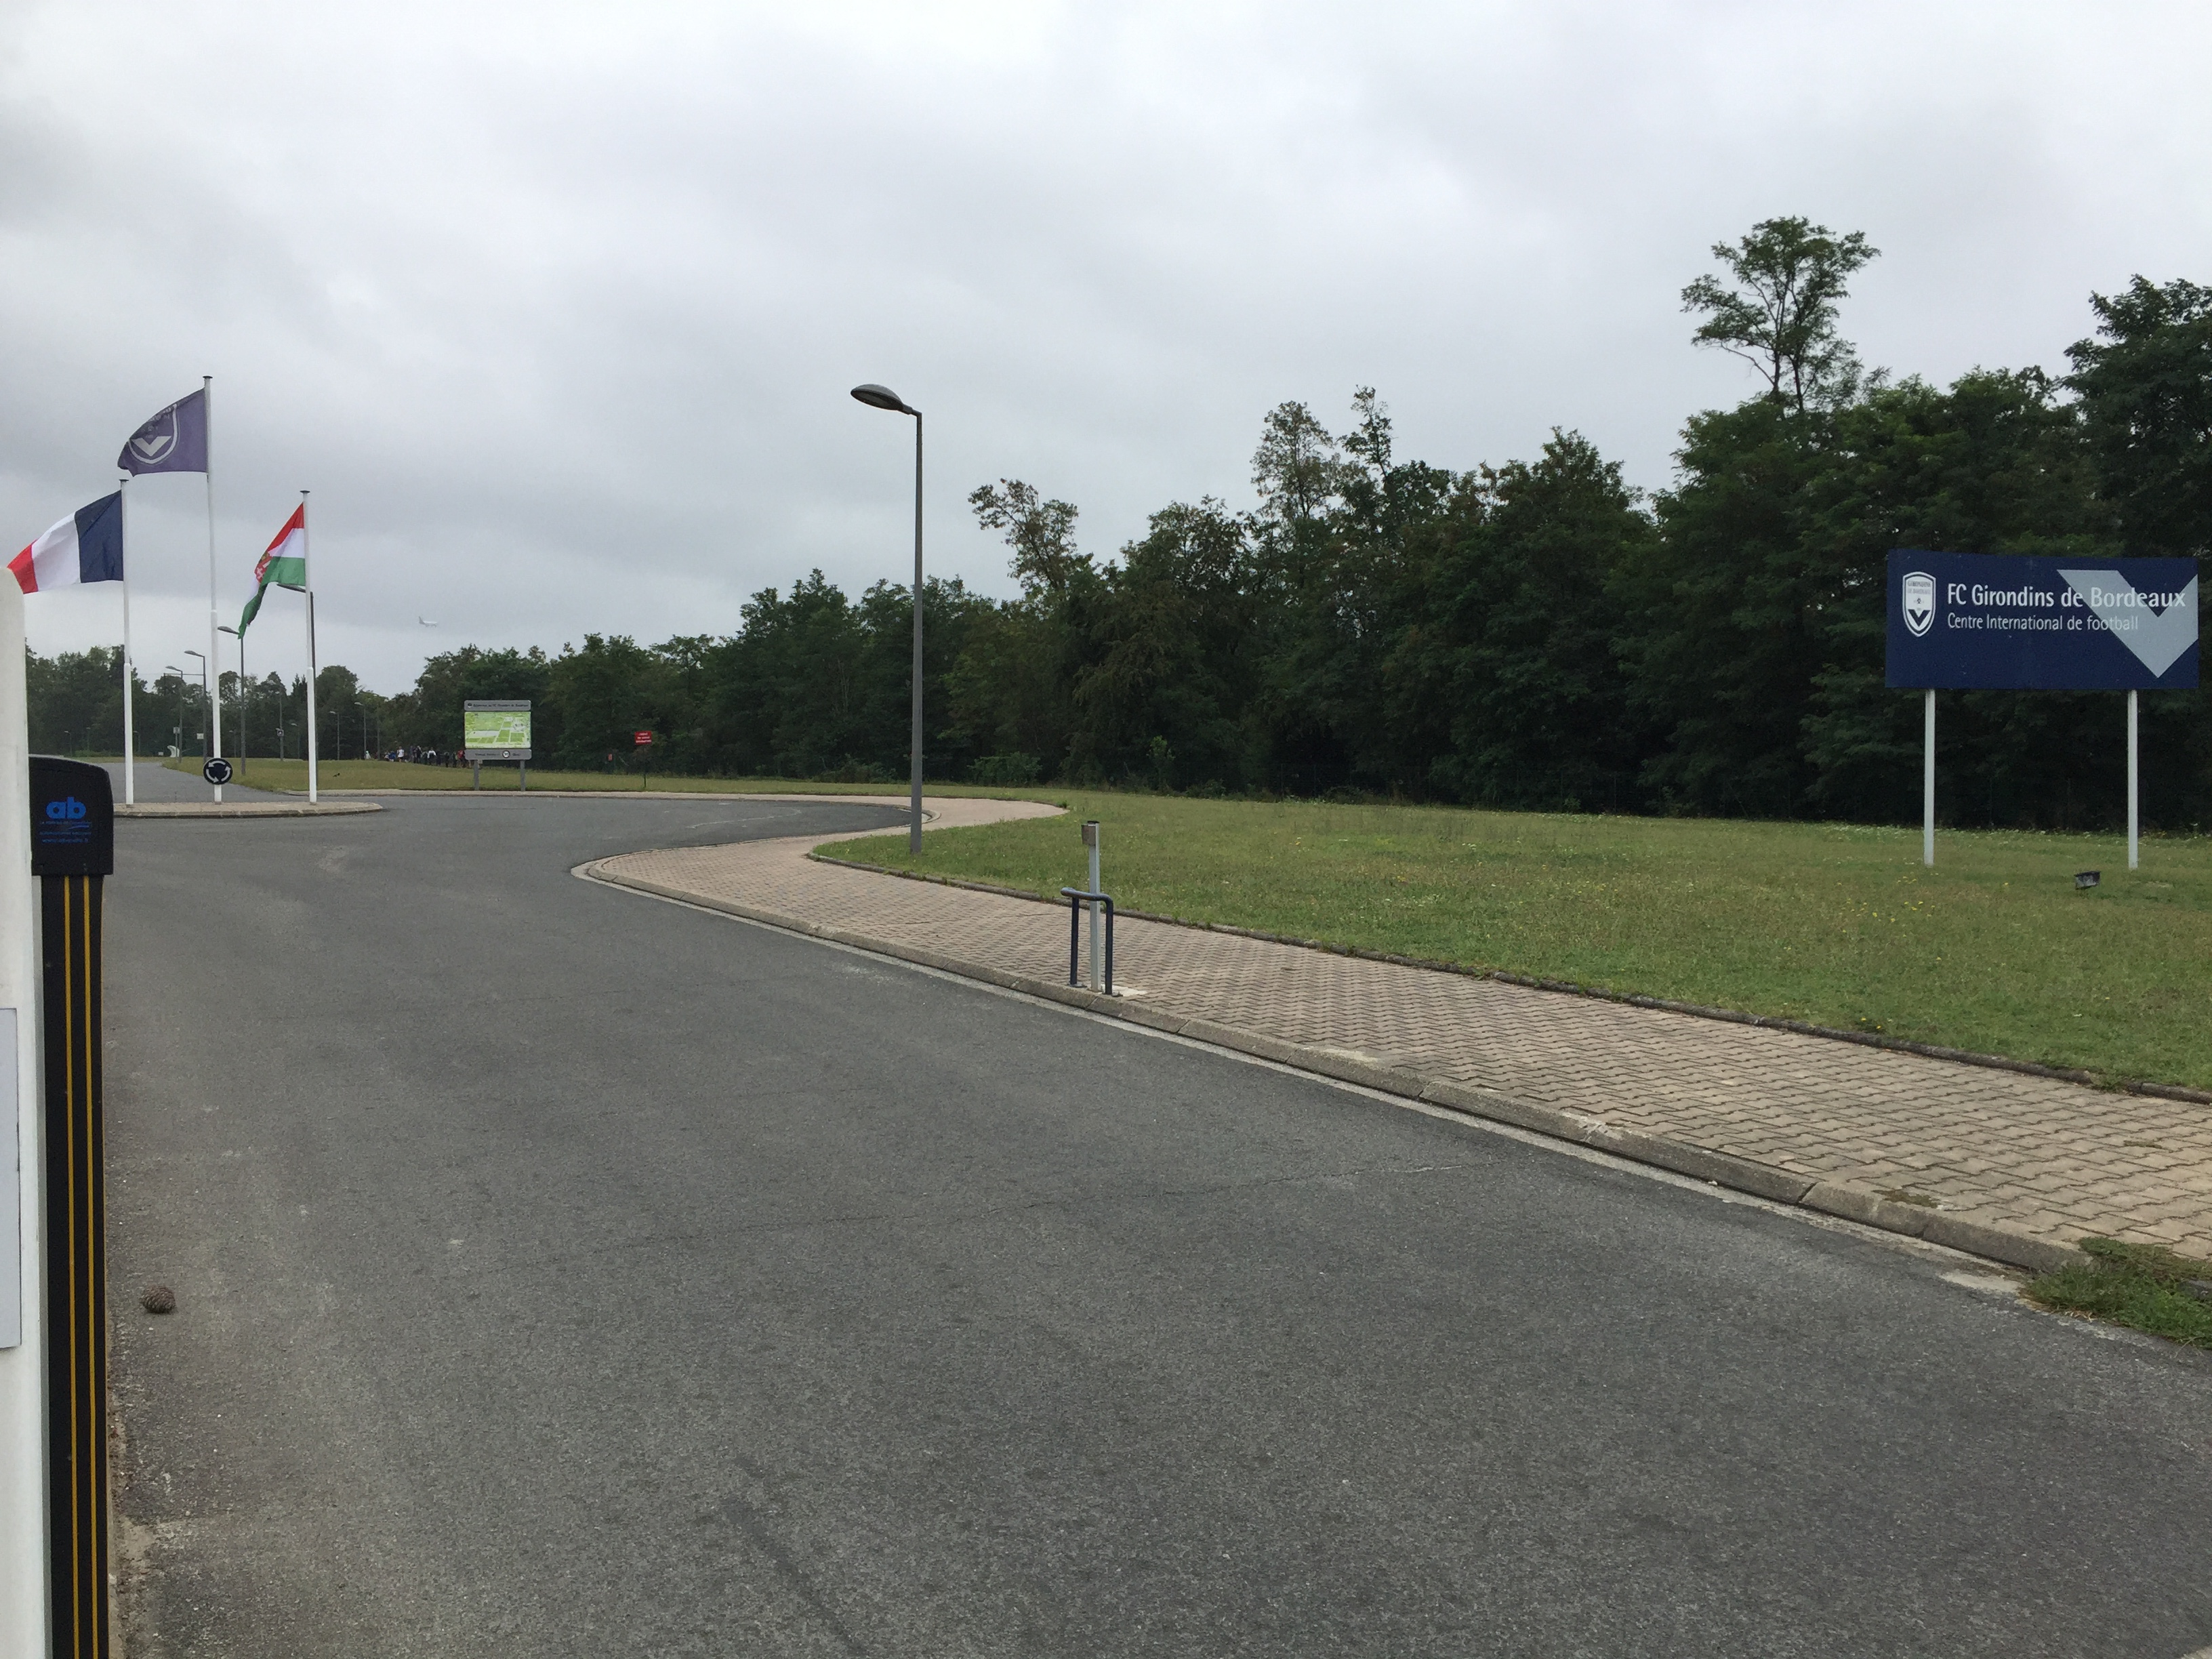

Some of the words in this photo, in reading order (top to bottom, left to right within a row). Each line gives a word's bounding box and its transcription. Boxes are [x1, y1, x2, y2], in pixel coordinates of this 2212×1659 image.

[1947, 583, 1967, 605] FC
[1971, 583, 2055, 607] Girondins
[2060, 586, 2084, 608] de
[2090, 586, 2186, 608] Bordeaux
[1947, 611, 1984, 629] Centre
[1986, 613, 2063, 630] International
[2066, 615, 2083, 630] de
[2086, 615, 2139, 631] football
[45, 796, 87, 819] ab
